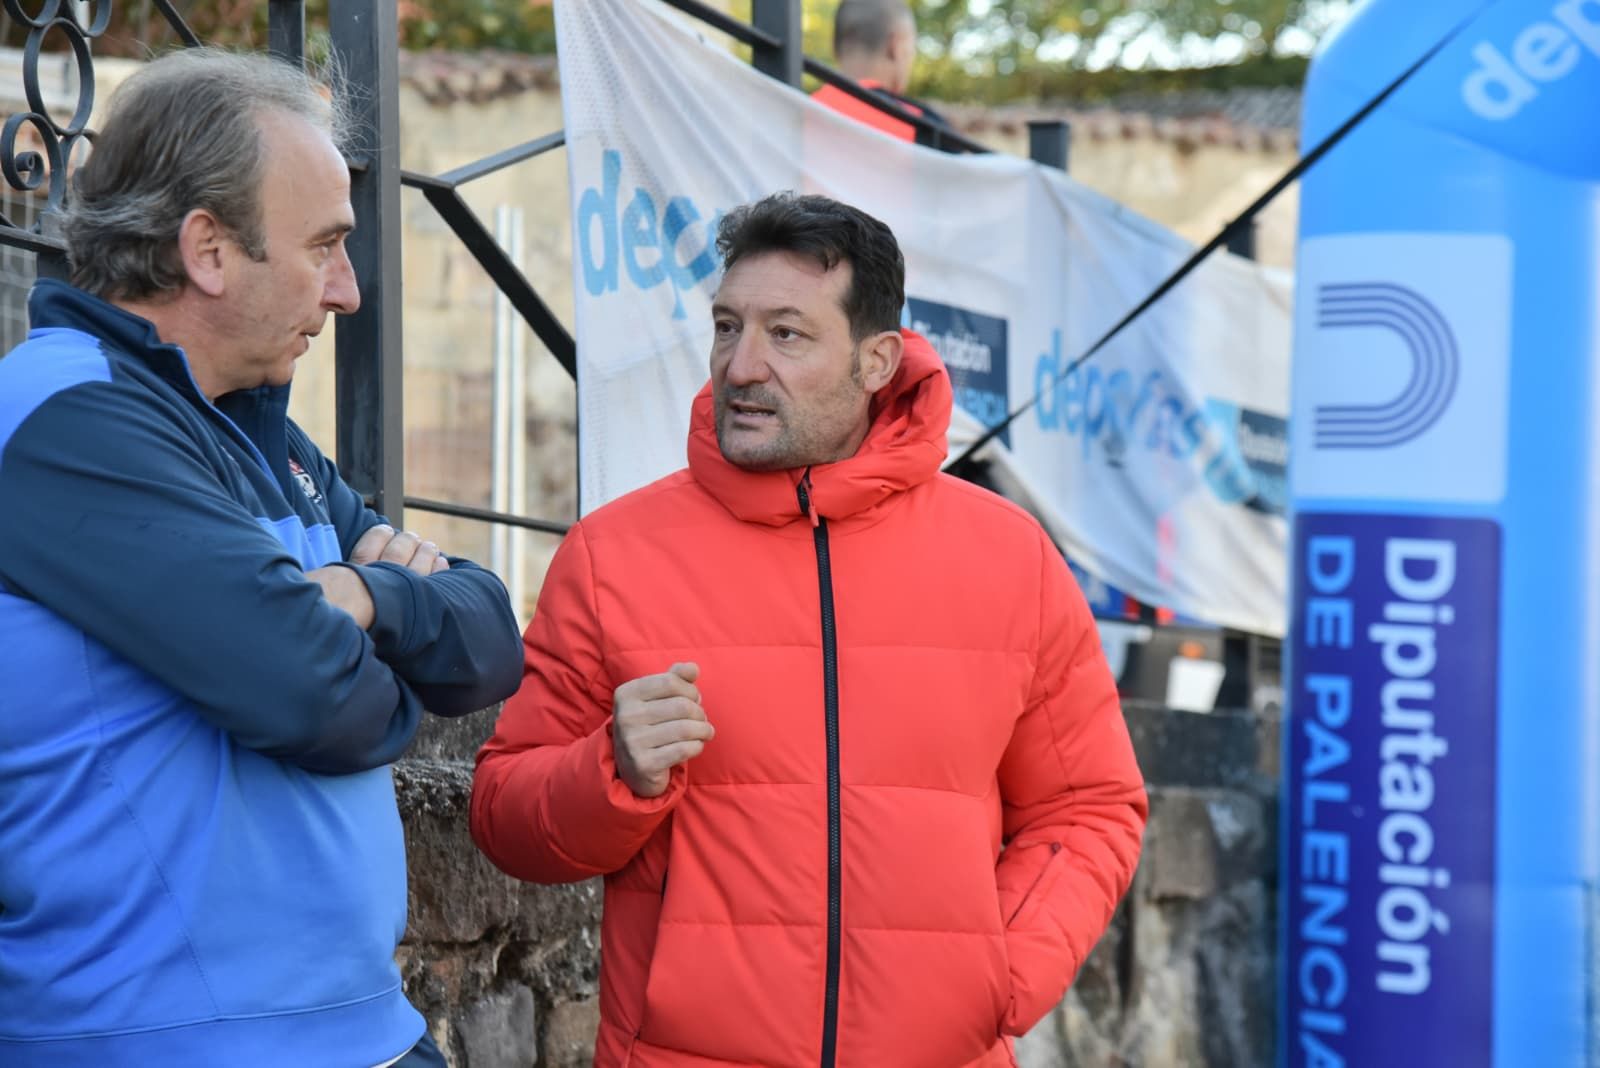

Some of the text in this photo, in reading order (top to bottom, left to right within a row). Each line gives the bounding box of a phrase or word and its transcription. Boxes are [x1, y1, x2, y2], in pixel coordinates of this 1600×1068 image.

[578, 149, 724, 320] dep
[1299, 536, 1355, 1068] DE PALENCIA
[1368, 537, 1457, 995] Diputación
